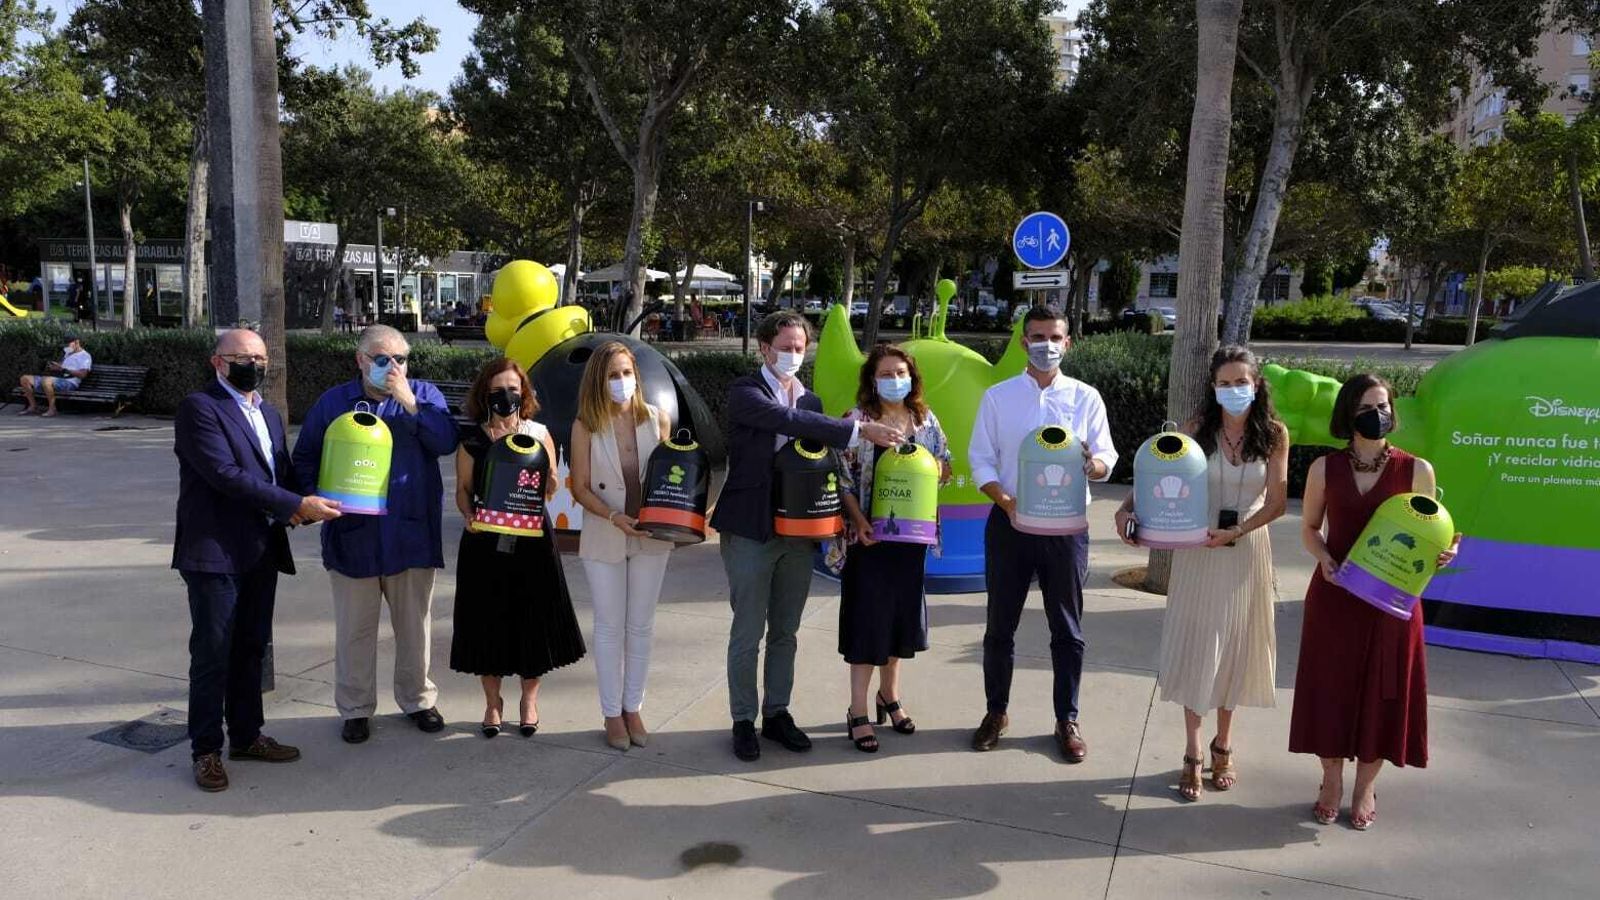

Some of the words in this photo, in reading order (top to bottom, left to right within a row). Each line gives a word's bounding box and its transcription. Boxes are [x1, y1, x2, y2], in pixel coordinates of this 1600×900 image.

[67, 244, 111, 257] TERRZAS
[1452, 431, 1501, 446] Soñar
[1505, 436, 1556, 448] nunca
[1562, 433, 1589, 449] fue
[1505, 454, 1558, 467] reciclar
[1501, 473, 1525, 483] Para
[1543, 475, 1583, 486] planeta
